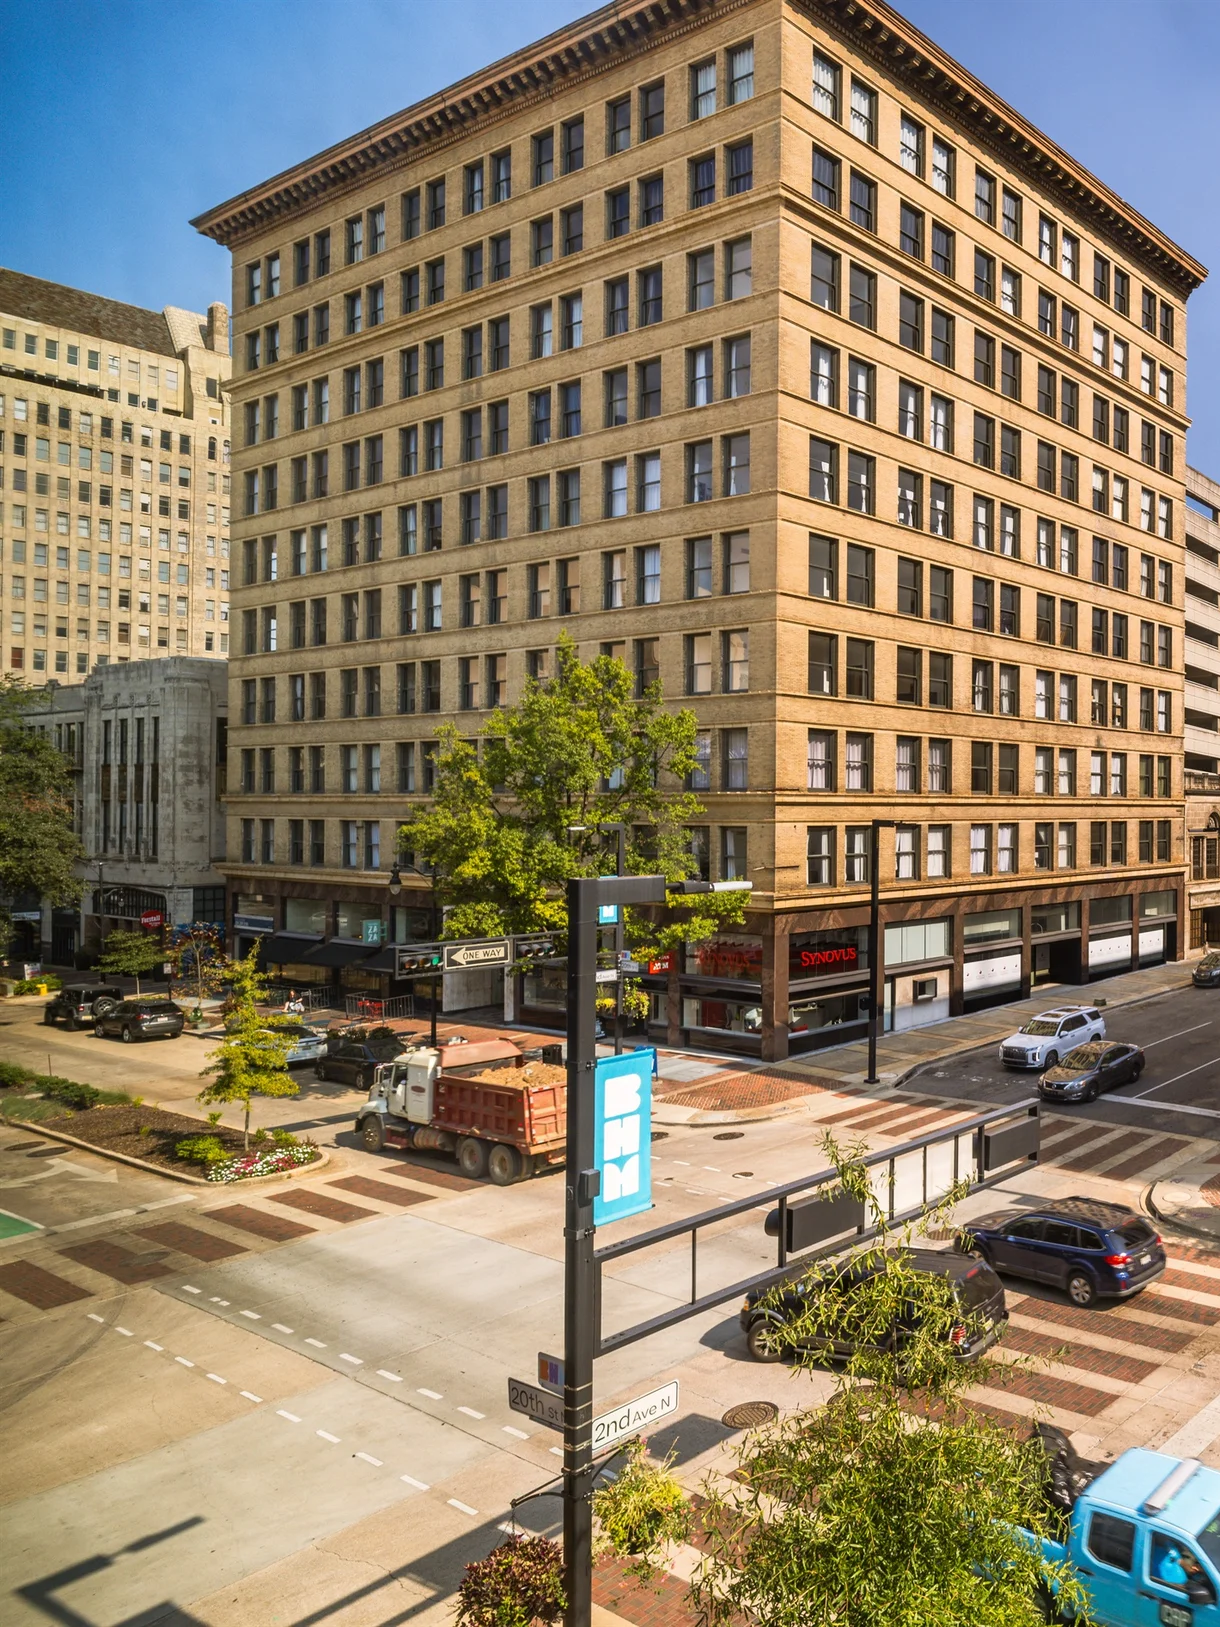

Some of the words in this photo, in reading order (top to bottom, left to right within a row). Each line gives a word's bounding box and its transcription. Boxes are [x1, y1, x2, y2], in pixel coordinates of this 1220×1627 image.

[368, 934, 378, 942] ZA
[462, 951, 480, 960] ONE
[483, 948, 502, 957] WAY
[801, 948, 857, 967] SYNOVUS
[602, 1073, 642, 1203] BHM
[511, 1386, 545, 1416] 20th
[594, 1408, 631, 1443] 2nd
[632, 1404, 657, 1425] Ave
[660, 1395, 671, 1411] N
